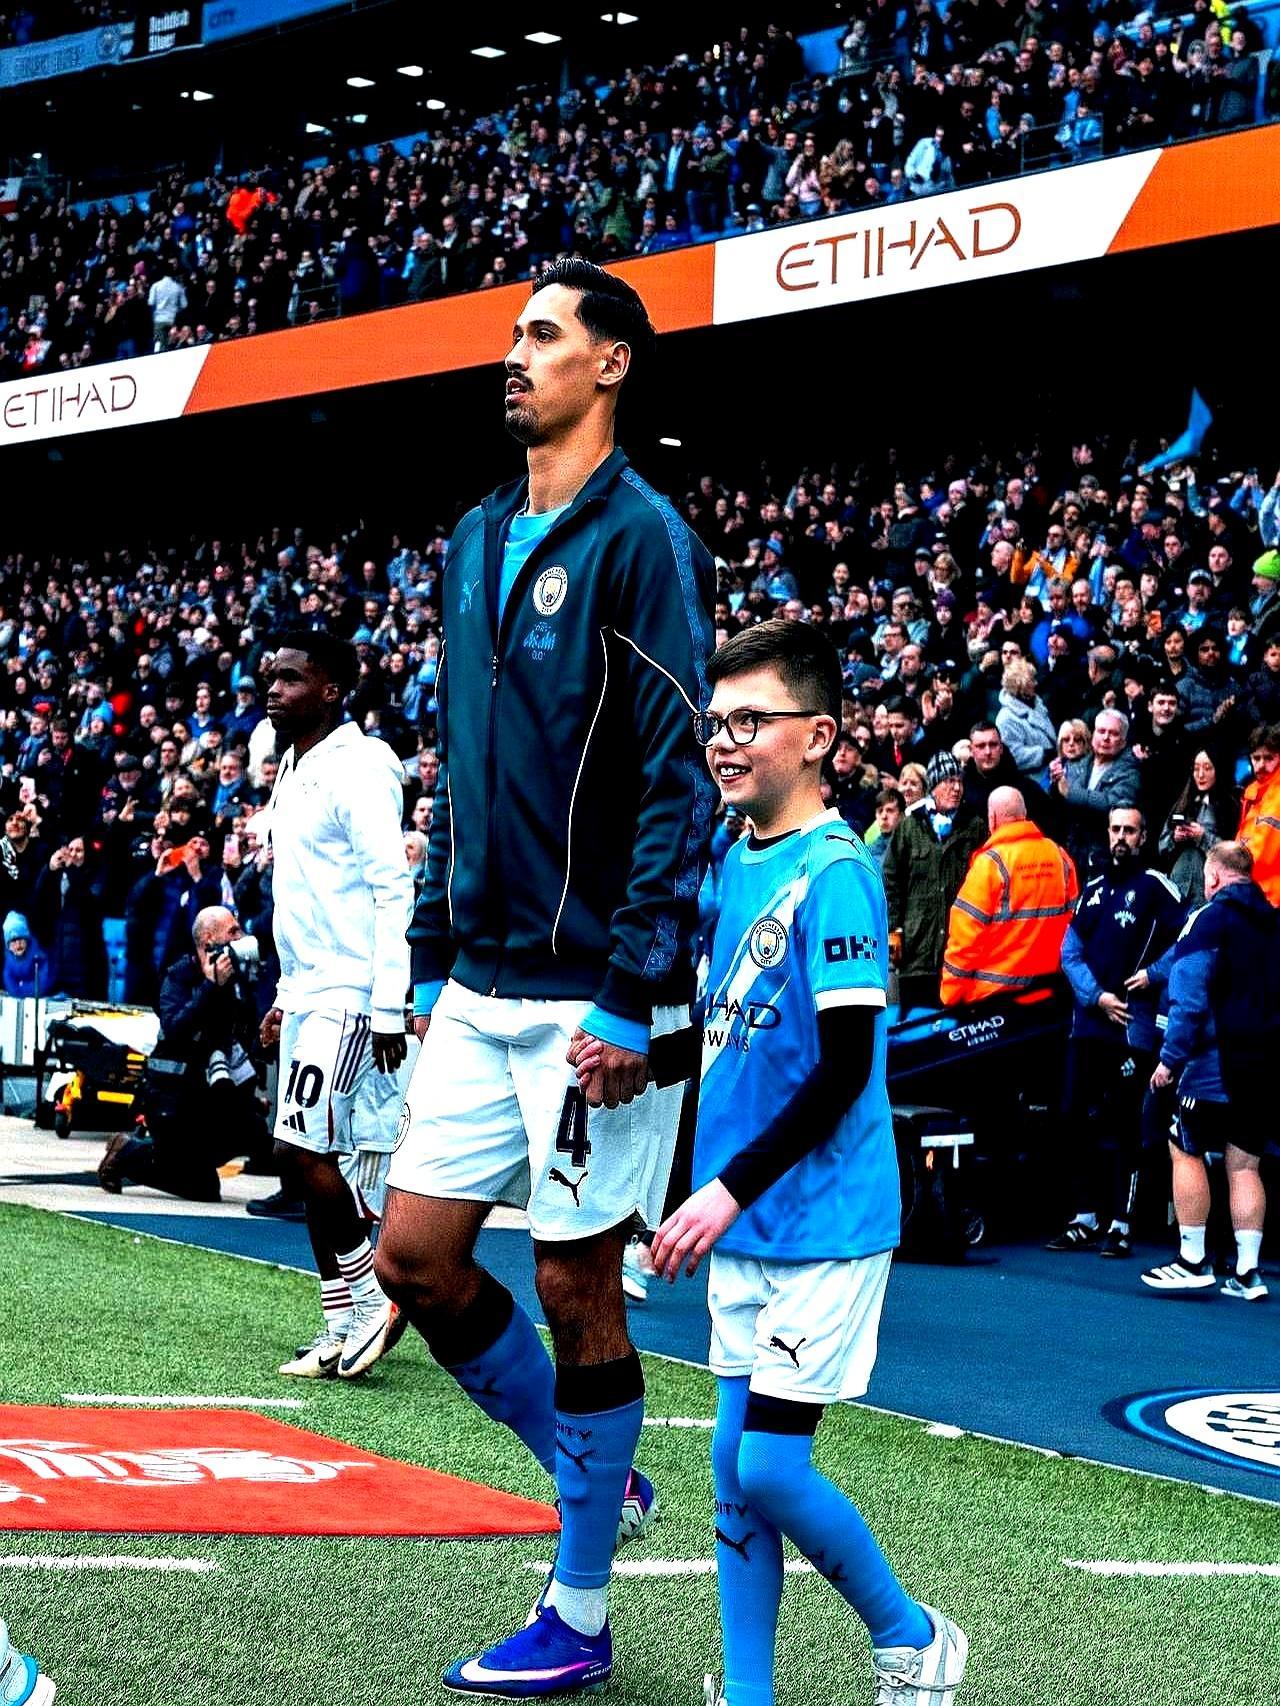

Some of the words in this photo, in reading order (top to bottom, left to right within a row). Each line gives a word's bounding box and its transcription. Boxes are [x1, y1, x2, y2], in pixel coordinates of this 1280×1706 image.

[776, 202, 1021, 291] ETIHAD
[4, 374, 137, 428] ETIHAD
[708, 991, 782, 1030] HAD
[948, 1015, 1005, 1042] ETIHAD
[703, 1029, 750, 1053] WAYS
[284, 1059, 324, 1109] 10
[555, 1085, 592, 1168] 4
